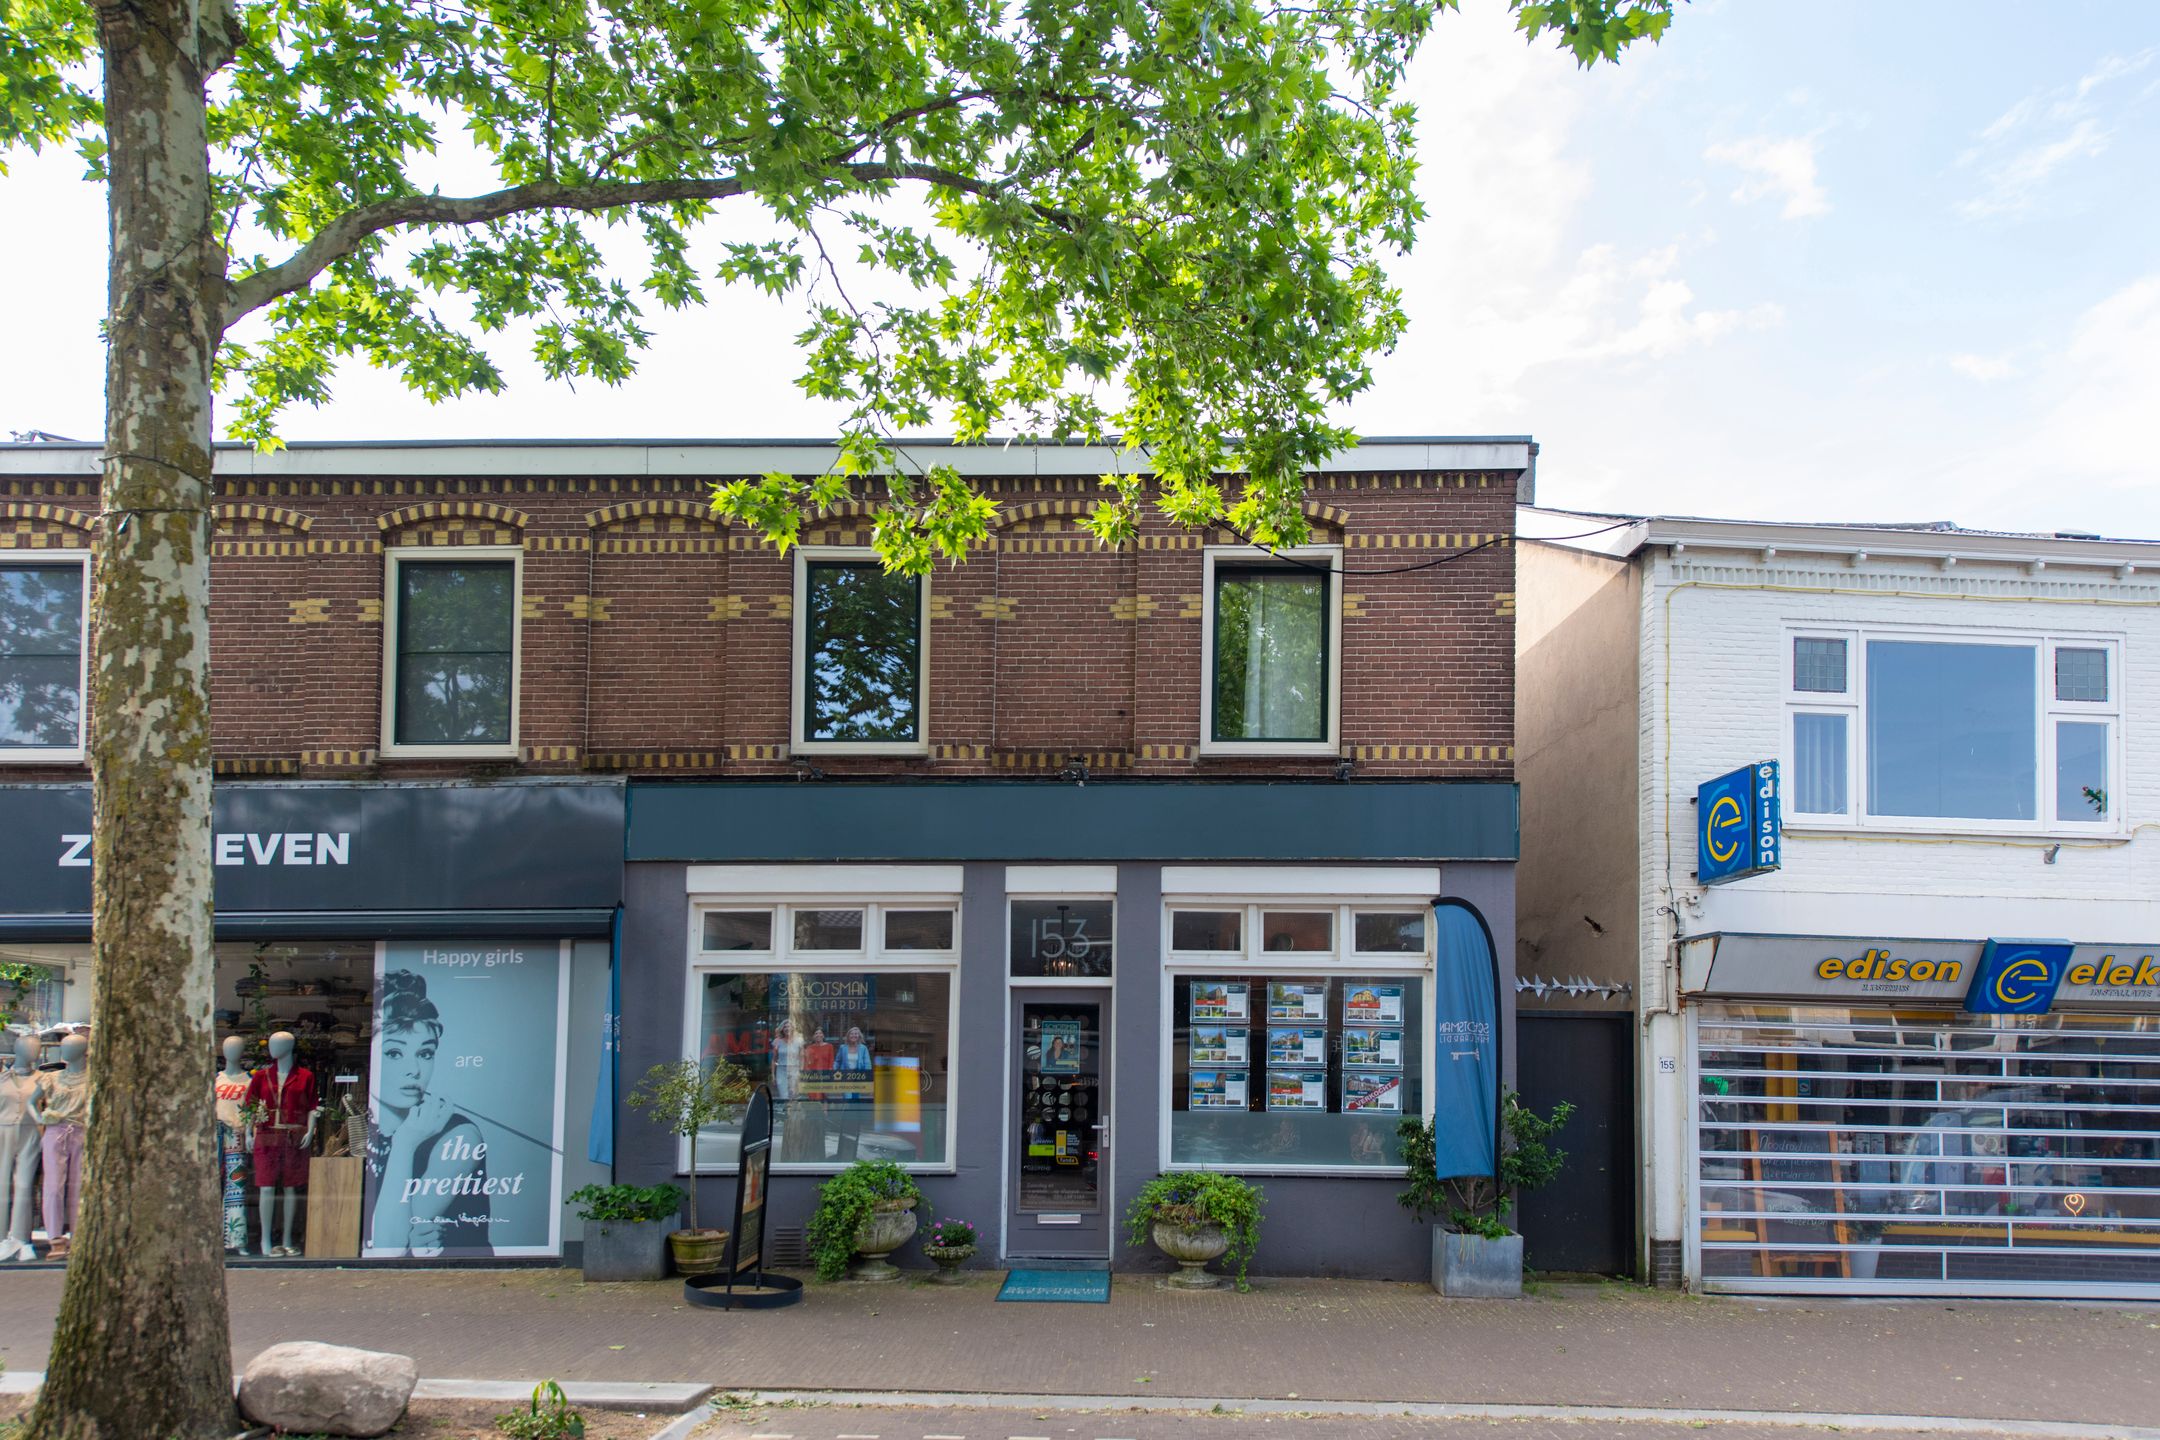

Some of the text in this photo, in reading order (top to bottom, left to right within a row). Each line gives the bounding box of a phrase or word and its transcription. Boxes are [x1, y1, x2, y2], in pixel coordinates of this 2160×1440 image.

[1758, 765, 1775, 863] edison
[58, 833, 350, 867] Z EVEN
[1031, 918, 1090, 958] 153
[423, 948, 524, 967] Happy girls
[1817, 948, 1963, 983] edison
[2069, 954, 2160, 986] elek
[778, 981, 869, 997] SCHOTSMAN
[778, 1000, 869, 1010] MELAARDIJ
[455, 1055, 484, 1067] are
[1660, 1060, 1675, 1069] 155
[847, 1072, 866, 1080] 2026
[1355, 1083, 1392, 1107] VERKOCHT
[440, 1135, 488, 1161] the
[400, 1170, 525, 1203] prettiest
